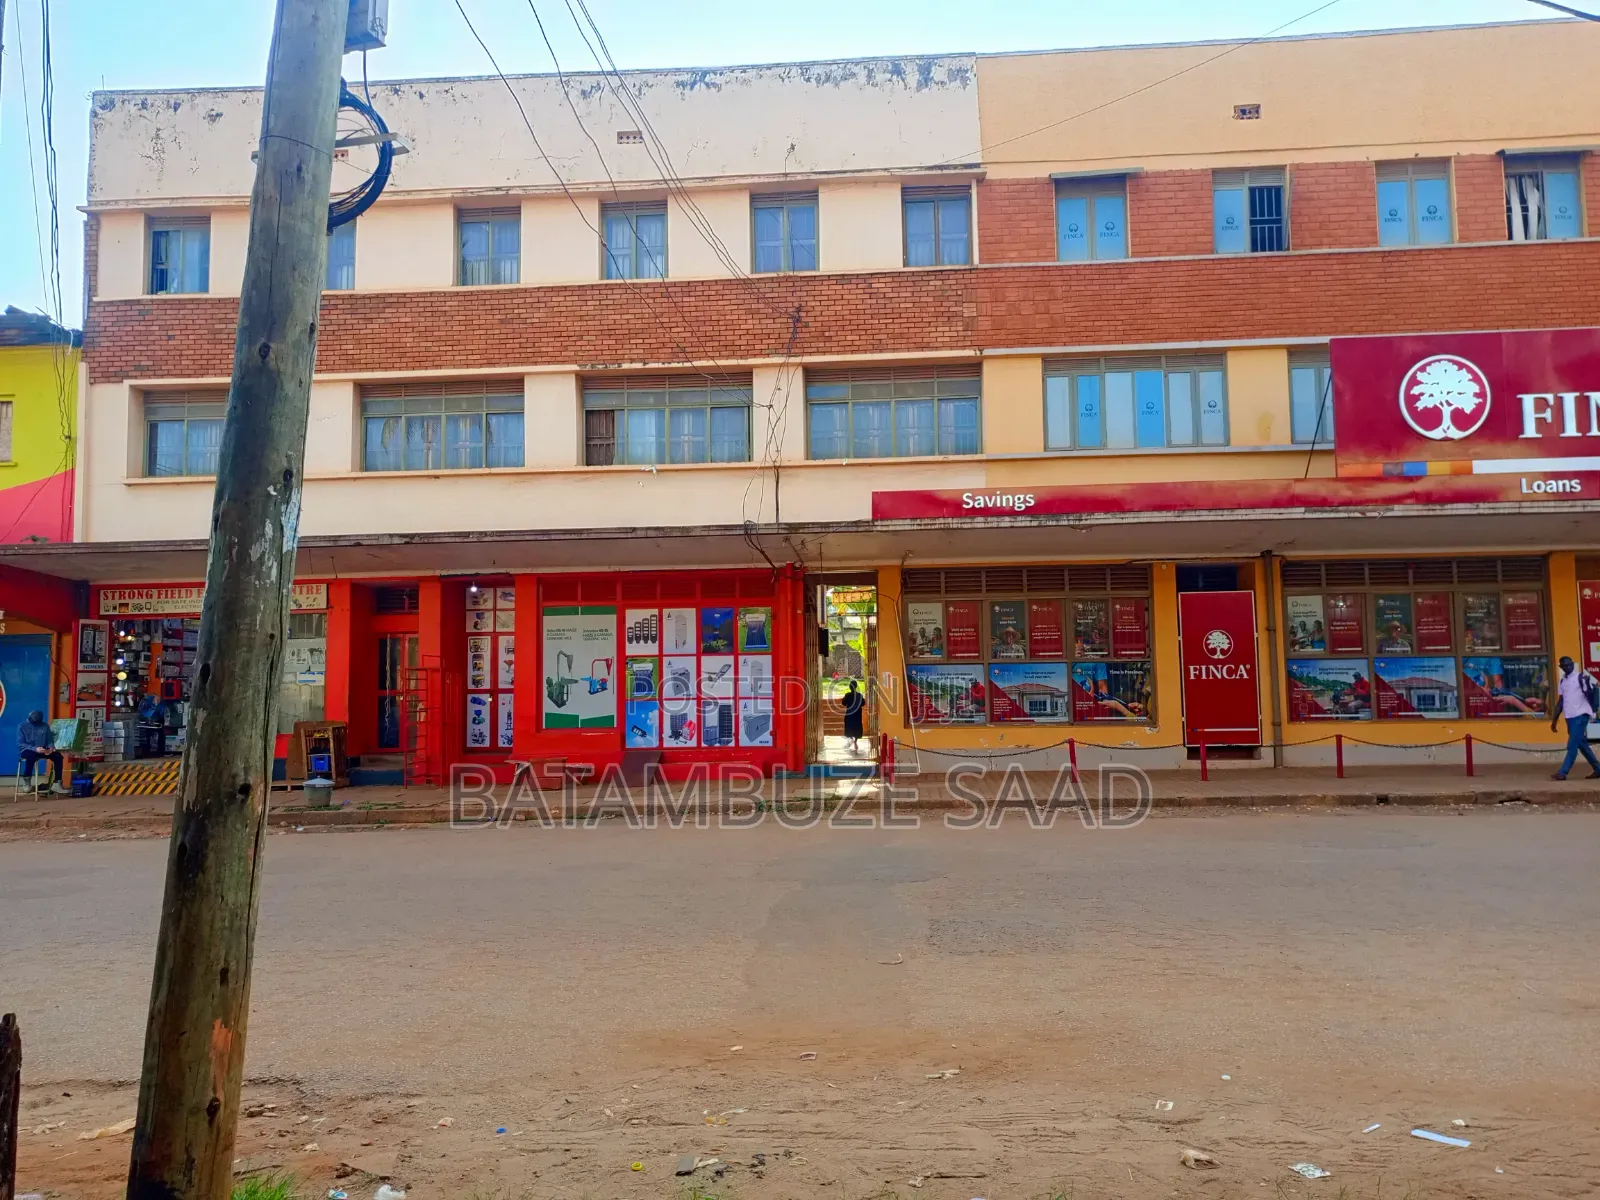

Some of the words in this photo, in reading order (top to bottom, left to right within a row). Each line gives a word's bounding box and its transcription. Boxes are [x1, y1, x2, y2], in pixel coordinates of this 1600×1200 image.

[1520, 477, 1582, 494] Loans
[962, 491, 1035, 511] Savings
[103, 589, 153, 601] STRONG
[156, 588, 194, 599] FIELD
[1189, 663, 1250, 680] FINCA
